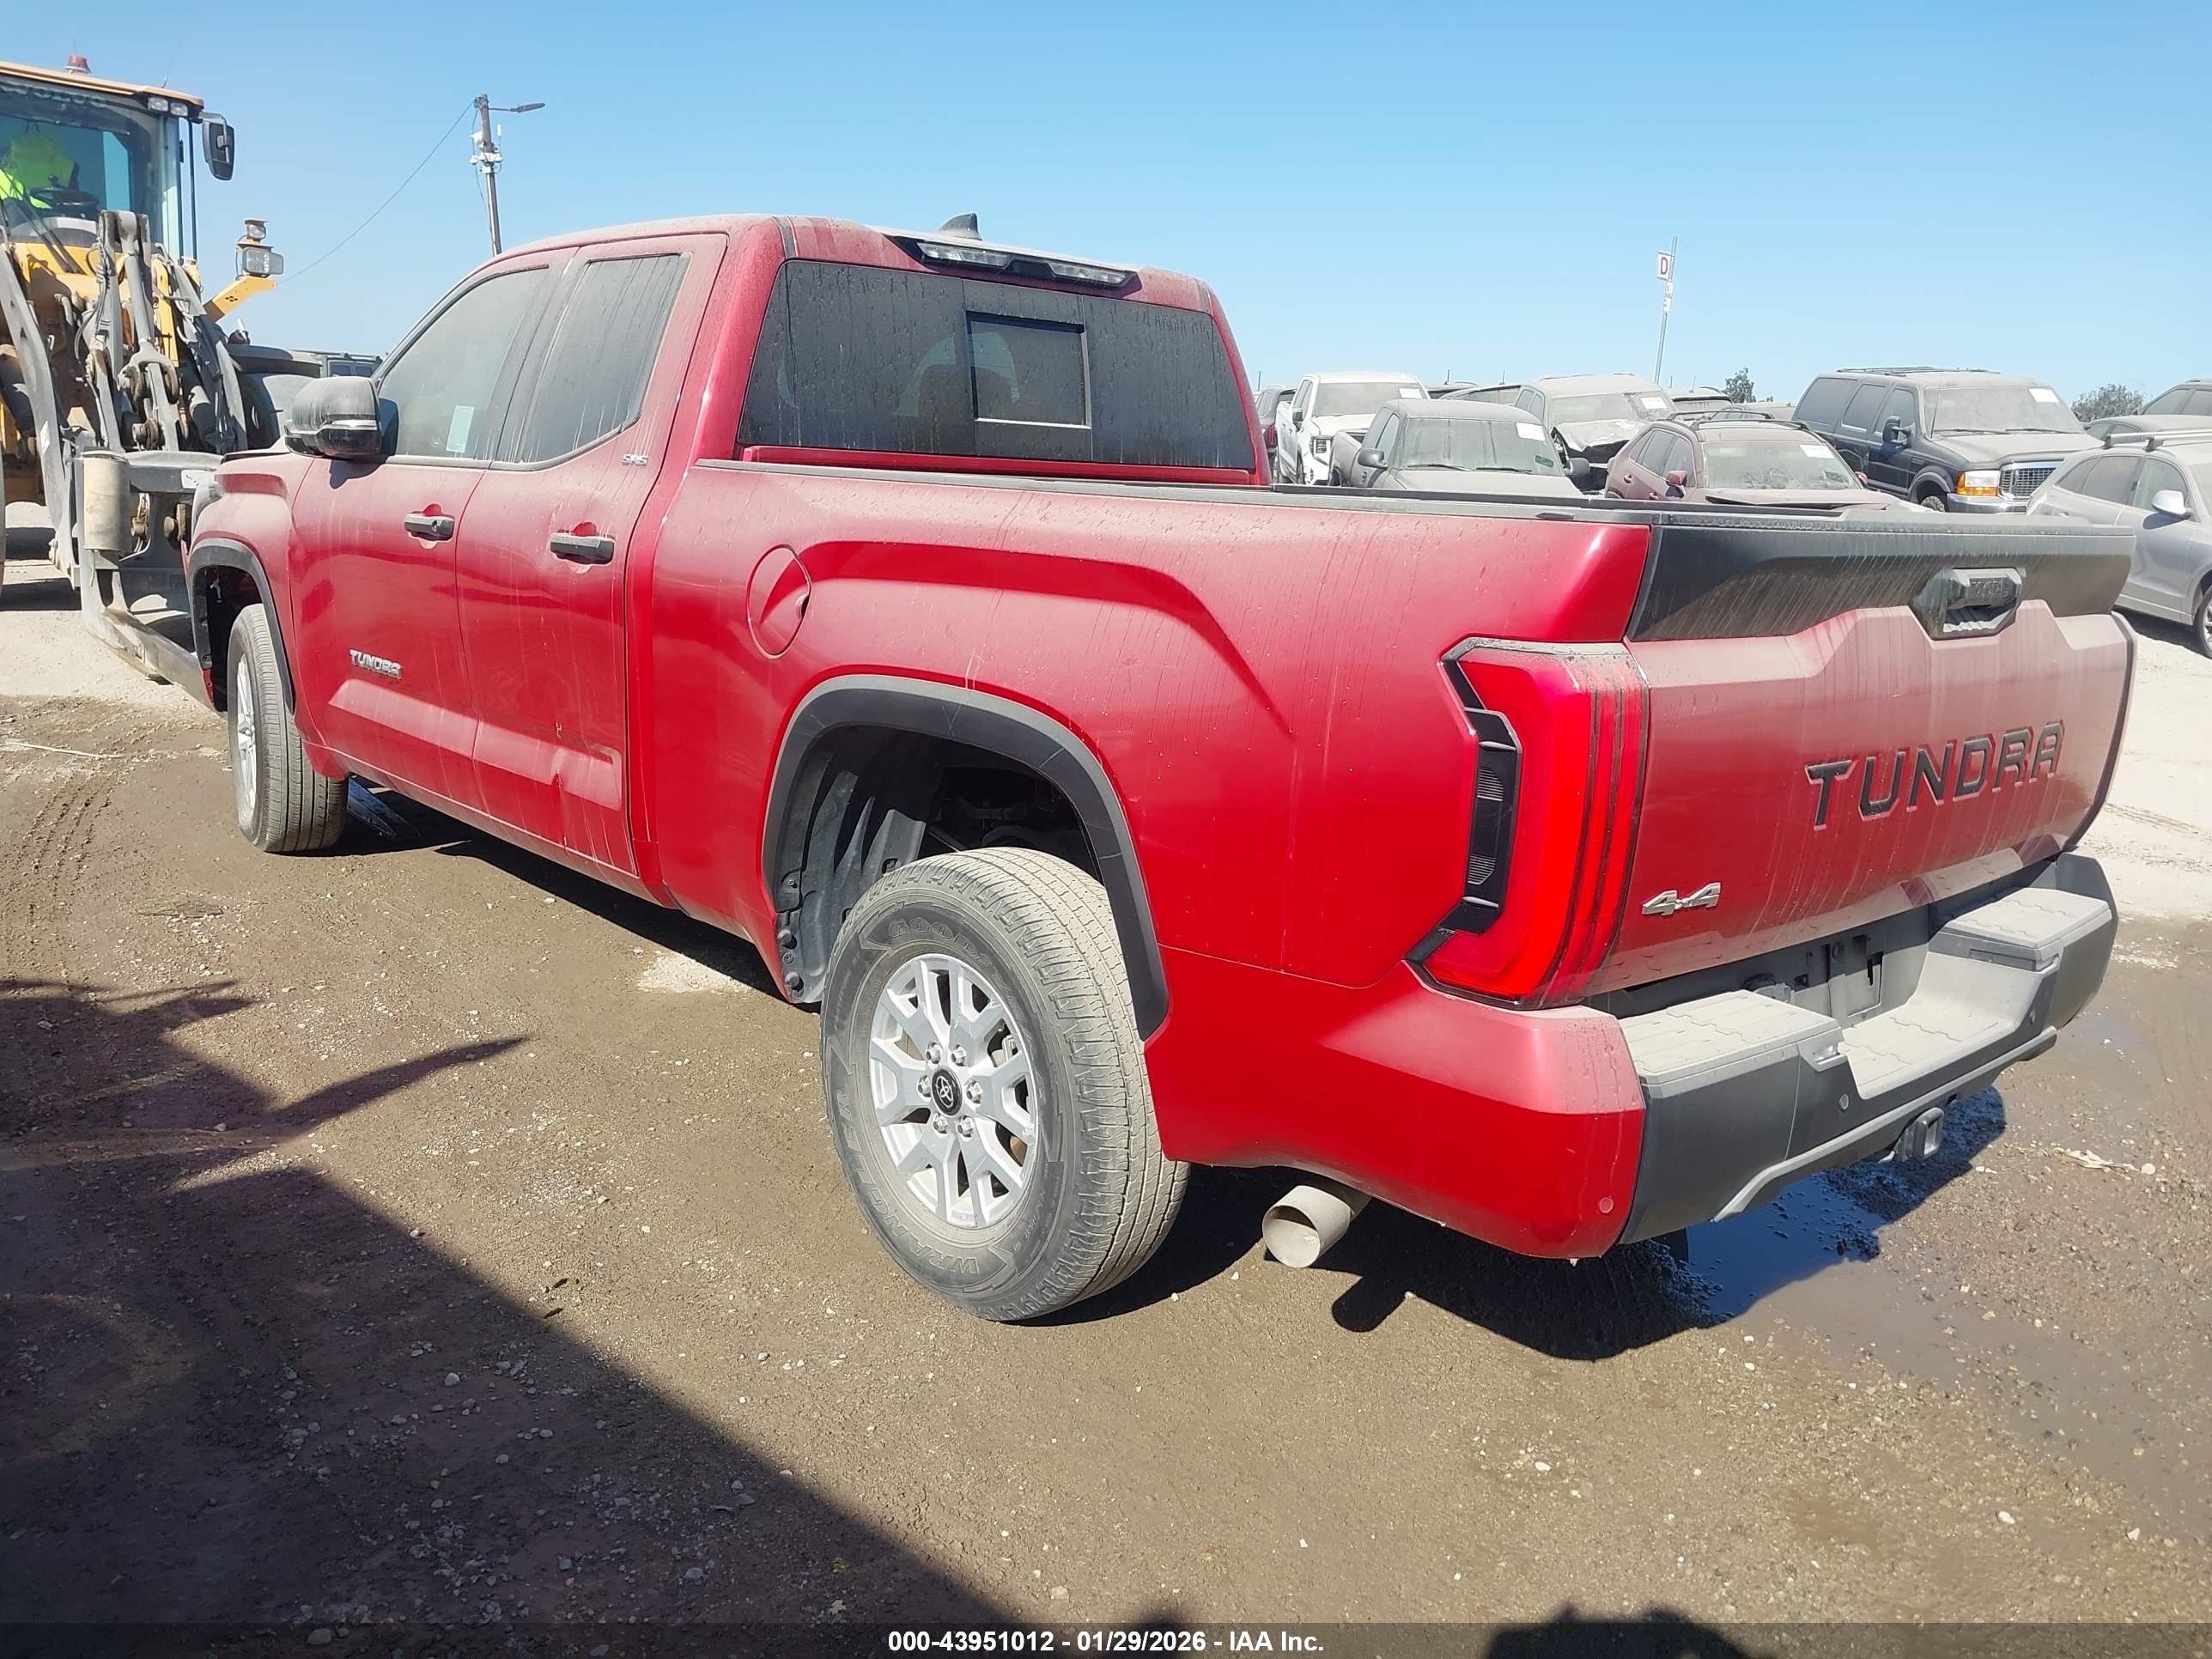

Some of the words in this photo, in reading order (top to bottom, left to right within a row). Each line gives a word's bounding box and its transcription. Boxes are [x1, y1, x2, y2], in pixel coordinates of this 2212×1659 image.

[1660, 256, 1668, 276] D
[349, 649, 402, 678] TUNDRA
[1805, 720, 2064, 831] TUNDRA
[836, 1090, 981, 1275] WRANGLER
